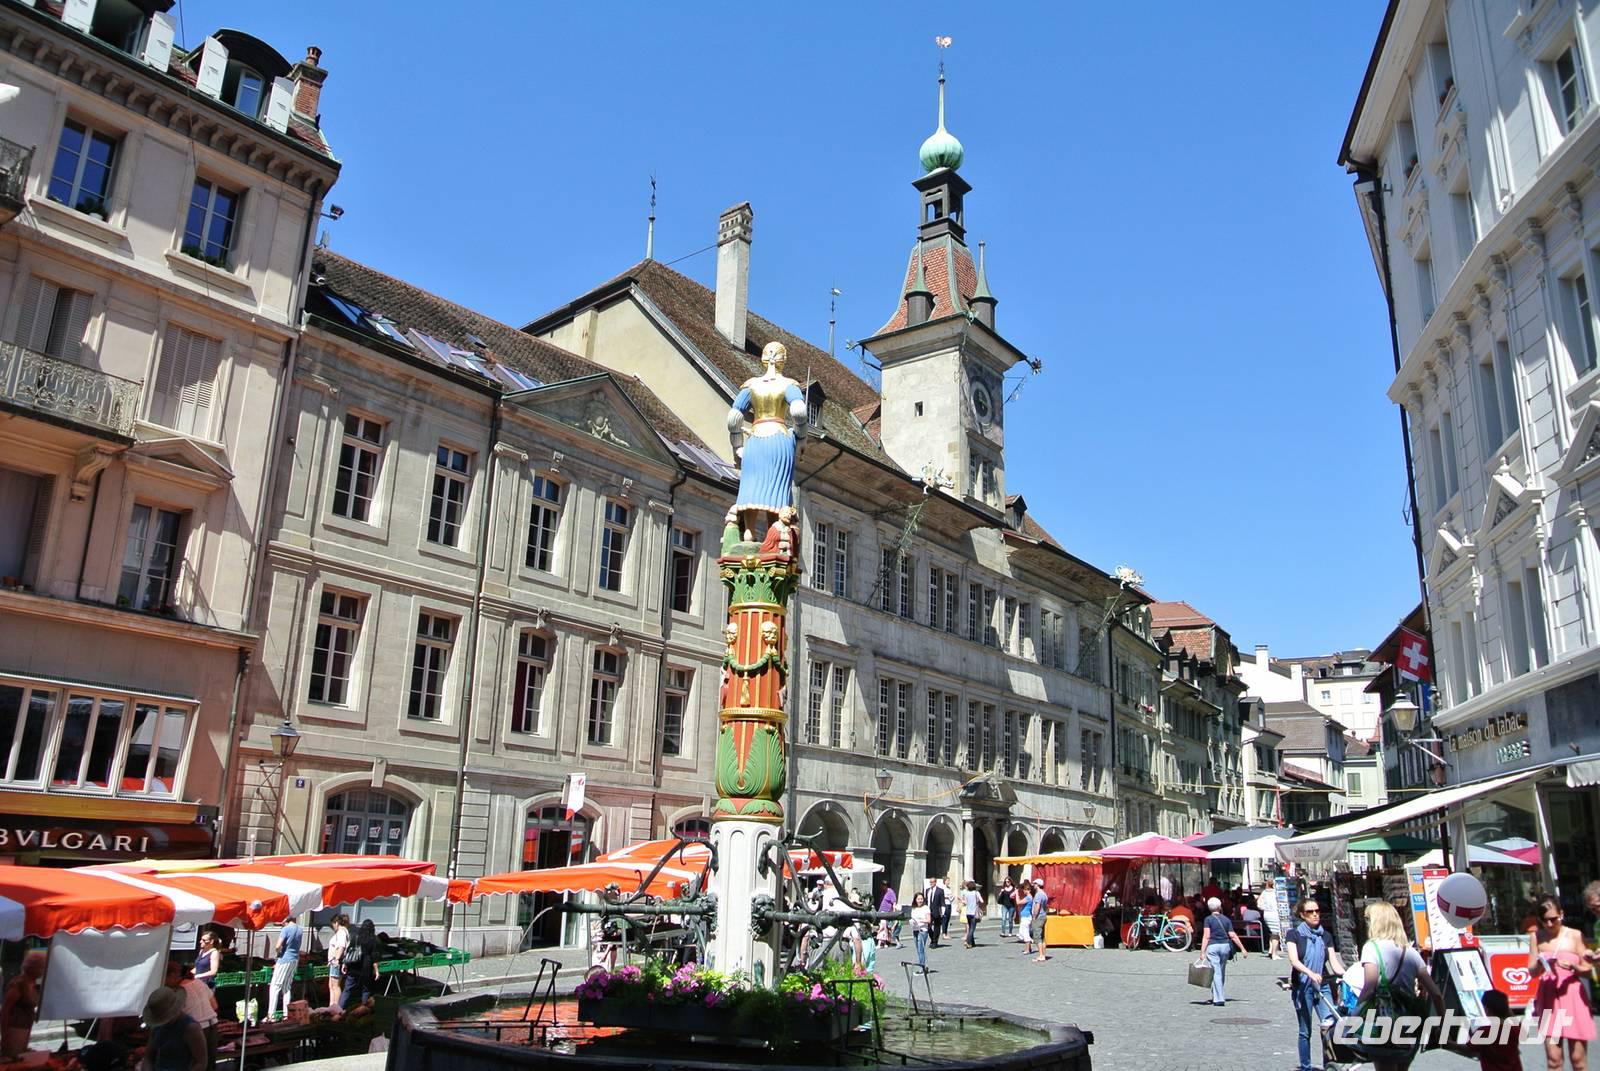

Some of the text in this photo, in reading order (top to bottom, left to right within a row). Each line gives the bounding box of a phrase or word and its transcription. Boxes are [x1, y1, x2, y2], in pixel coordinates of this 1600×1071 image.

[1458, 728, 1482, 749] maison
[1484, 718, 1495, 740] du
[1497, 712, 1523, 735] tabac
[0, 828, 149, 853] BVLGARI
